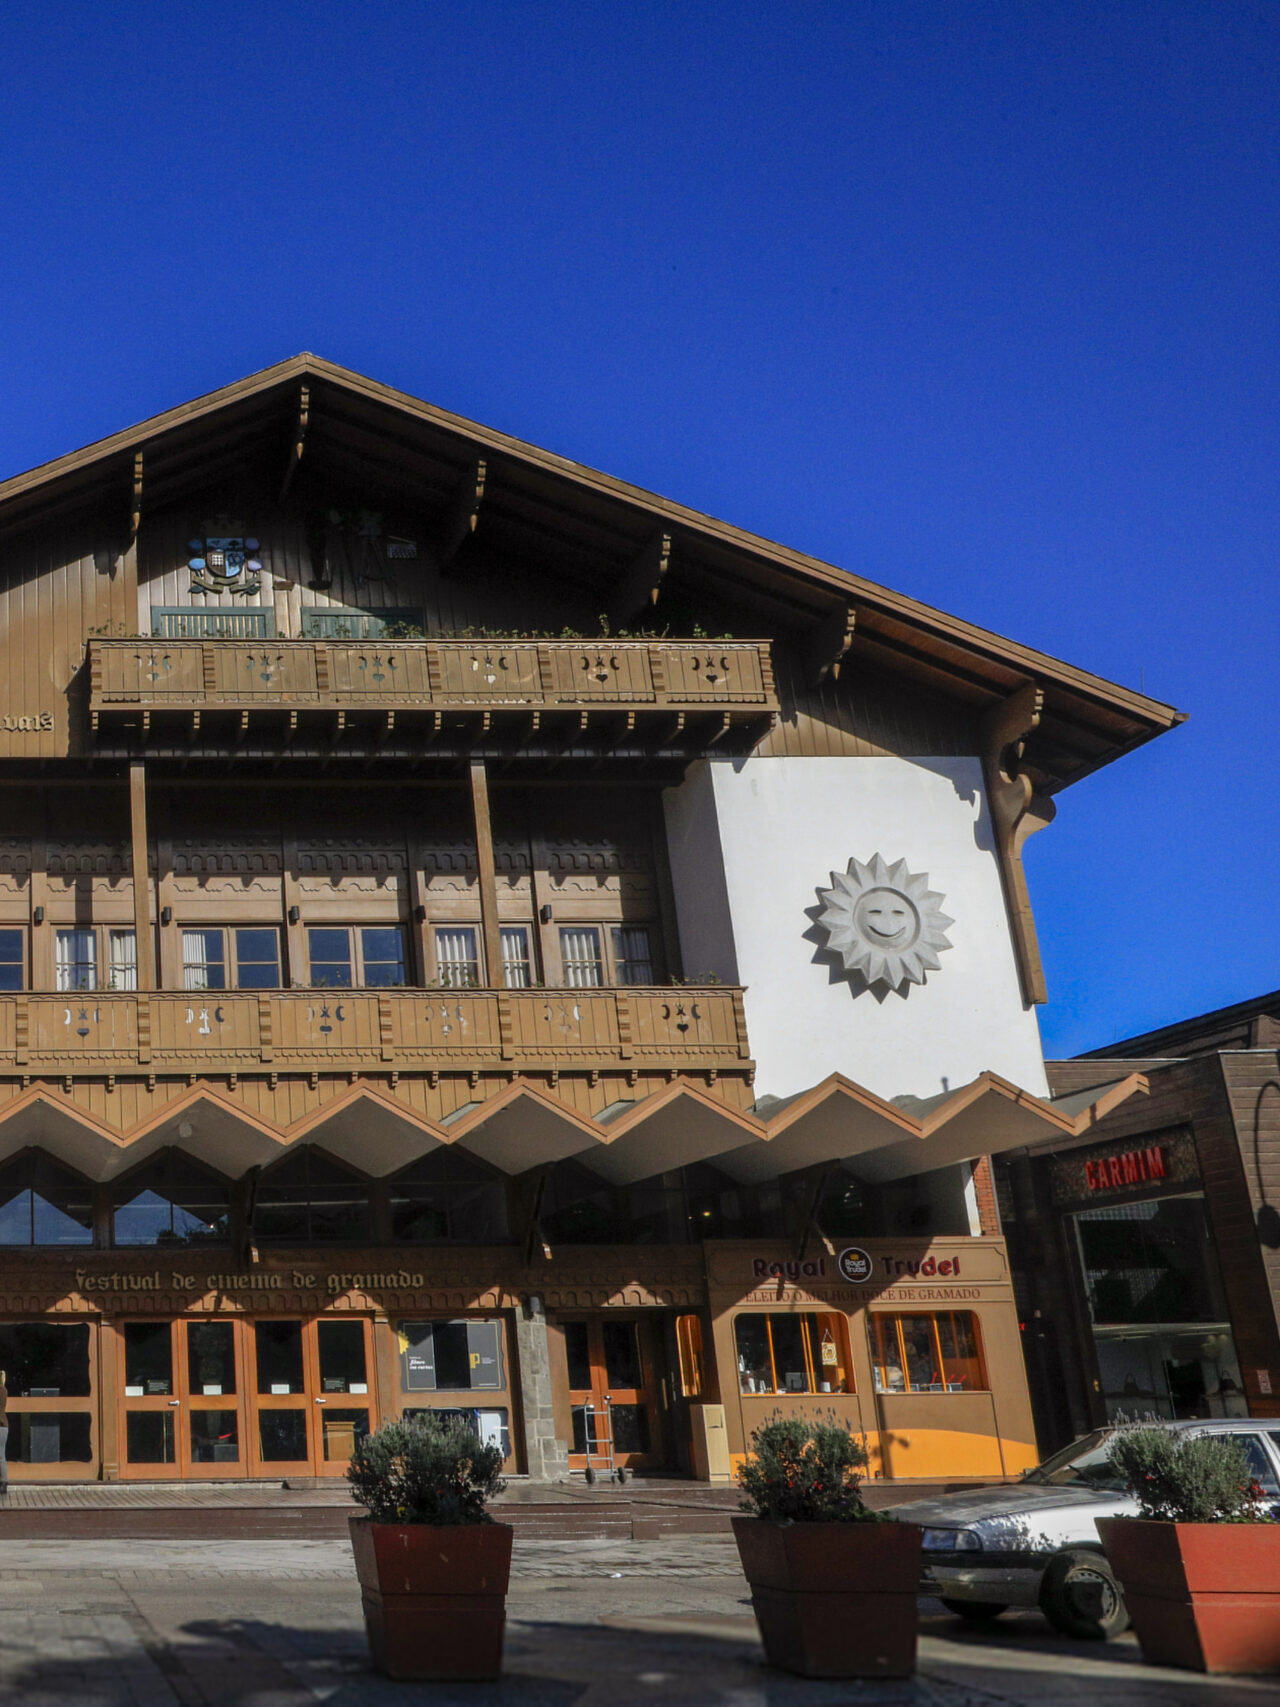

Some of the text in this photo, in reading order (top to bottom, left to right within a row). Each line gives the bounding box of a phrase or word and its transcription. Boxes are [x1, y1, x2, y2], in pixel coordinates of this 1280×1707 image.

[1085, 1146, 1166, 1190] CARMIM
[753, 1255, 961, 1281] Royal Trudel
[845, 1258, 866, 1268] Royal
[172, 1271, 197, 1290] de
[207, 1273, 282, 1290] cinema
[293, 1270, 318, 1288] de
[327, 1269, 424, 1294] gramado
[745, 1287, 981, 1303] ELEITO O MELHOR DOCE DE GRAMADO
